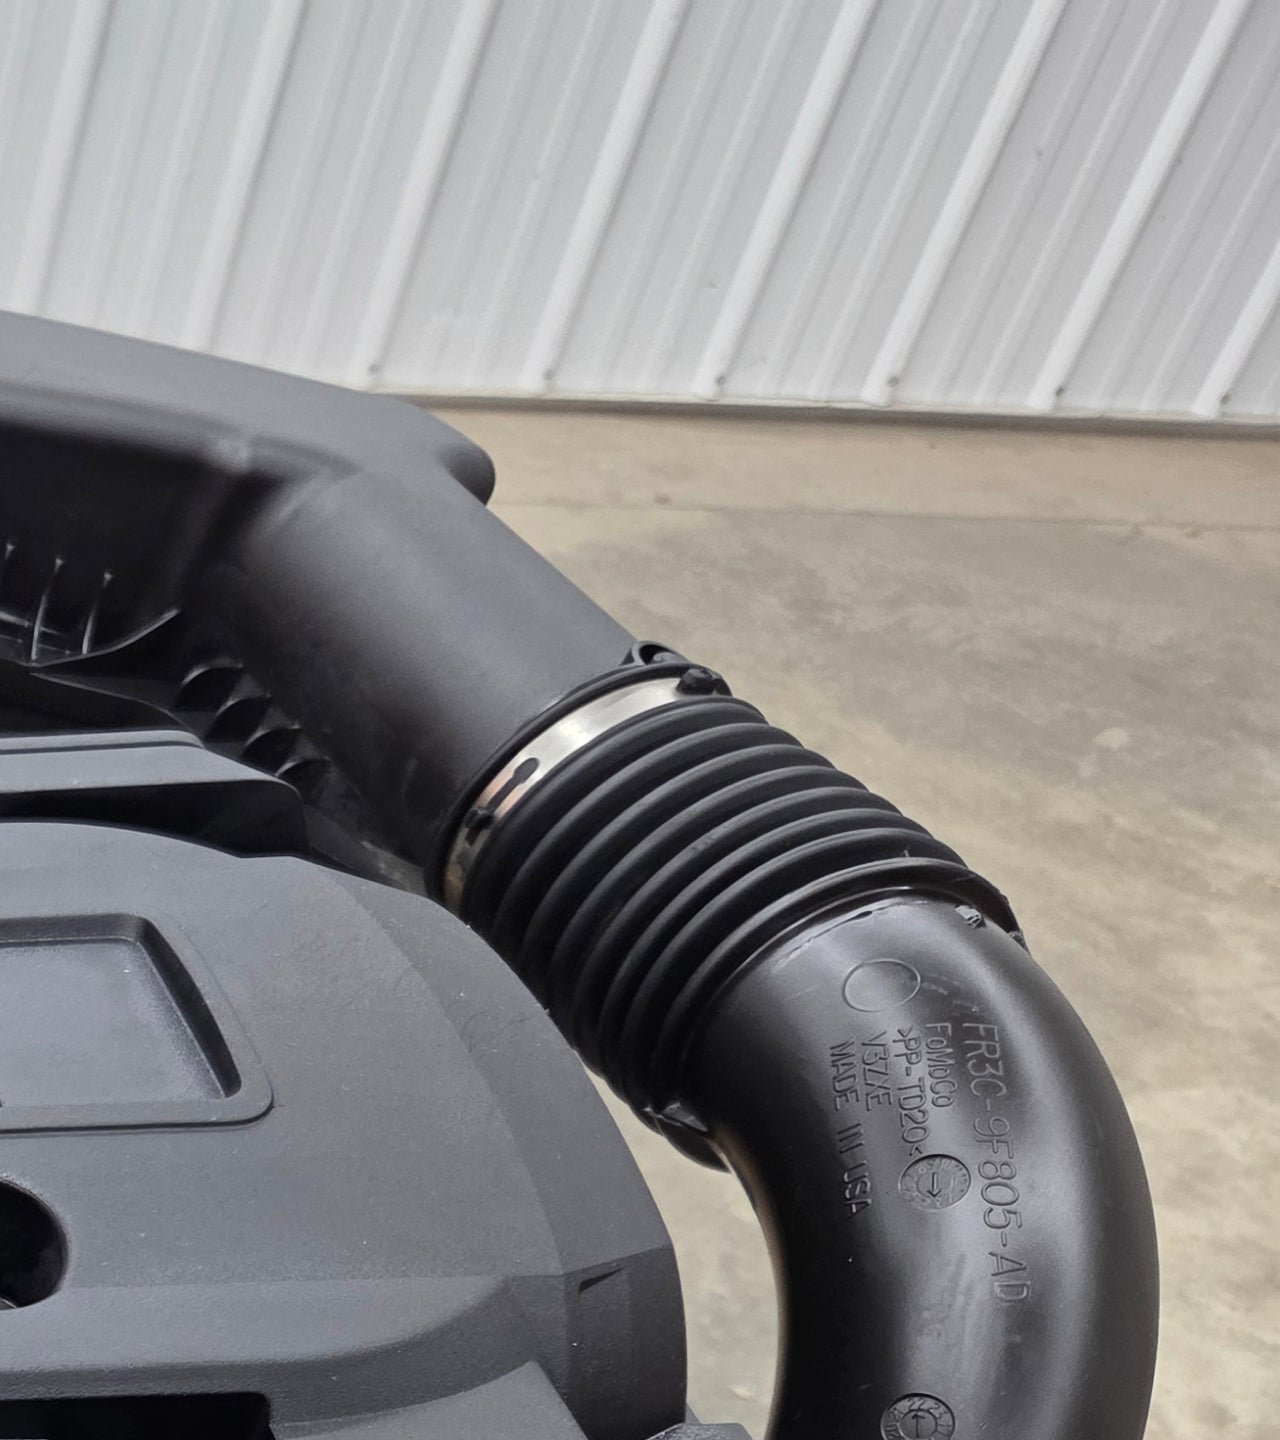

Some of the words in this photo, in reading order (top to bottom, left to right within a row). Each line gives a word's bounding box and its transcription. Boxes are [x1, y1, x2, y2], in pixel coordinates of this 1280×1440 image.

[830, 1037, 860, 1111] MADE
[925, 1022, 959, 1108] FoMoCo
[837, 1122, 864, 1154] IN
[963, 1021, 1031, 1302] FR3C-9F805-AD
[843, 1160, 872, 1216] USA
